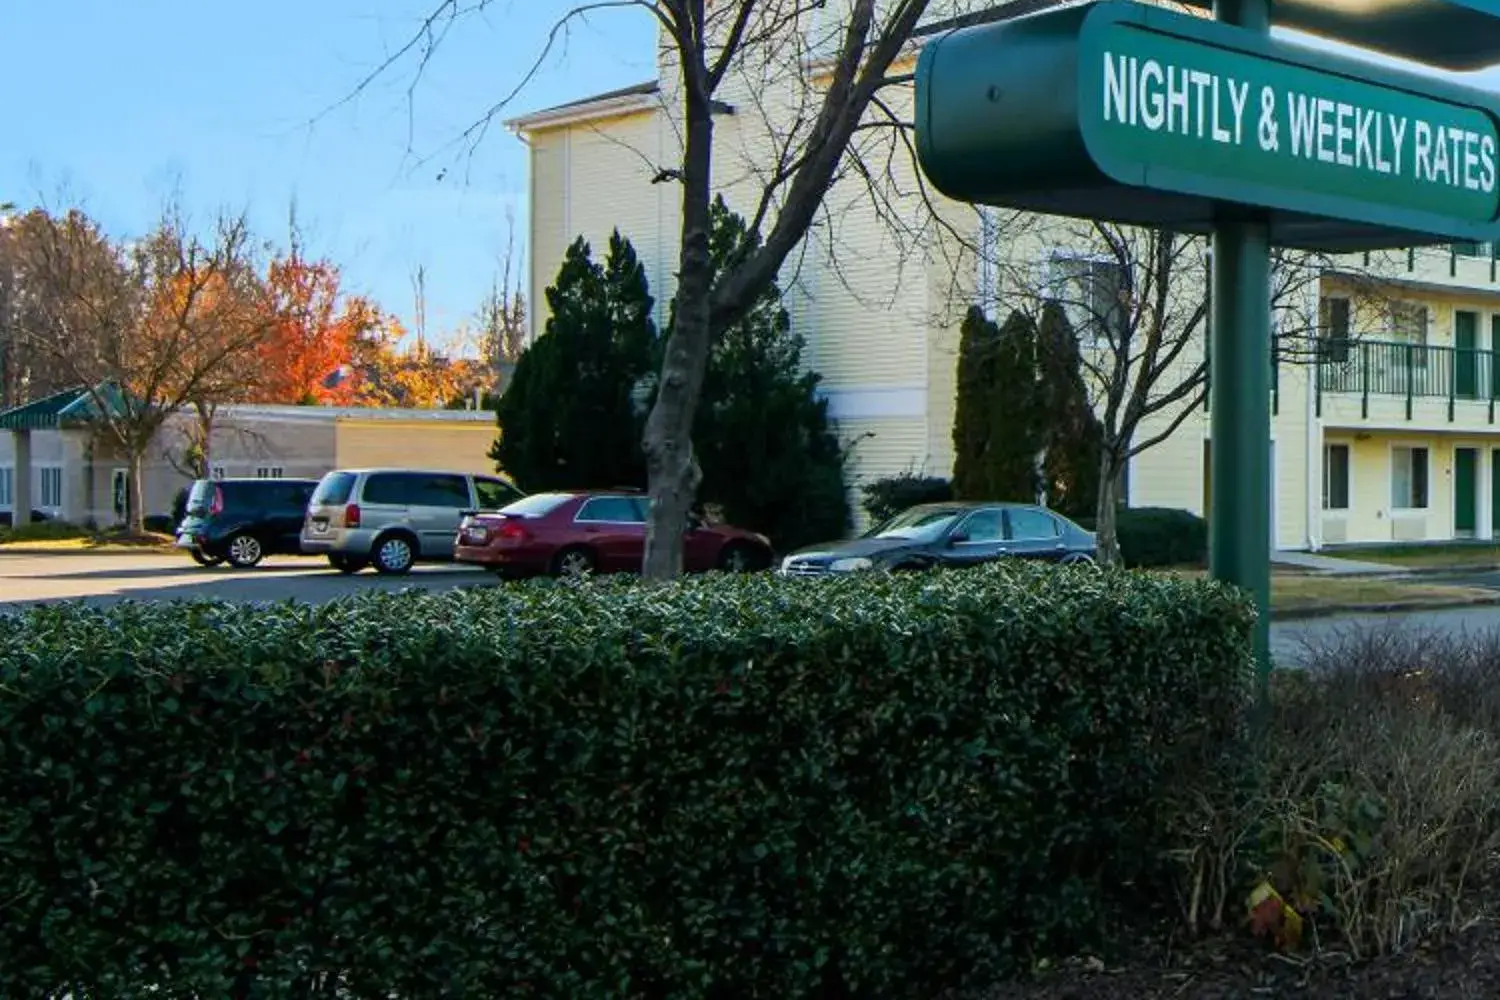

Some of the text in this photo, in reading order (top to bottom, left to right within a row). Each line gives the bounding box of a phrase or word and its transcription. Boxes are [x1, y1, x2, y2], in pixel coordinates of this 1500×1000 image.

[1103, 51, 1496, 193] NIGHTLY & WEEKLY RATES
